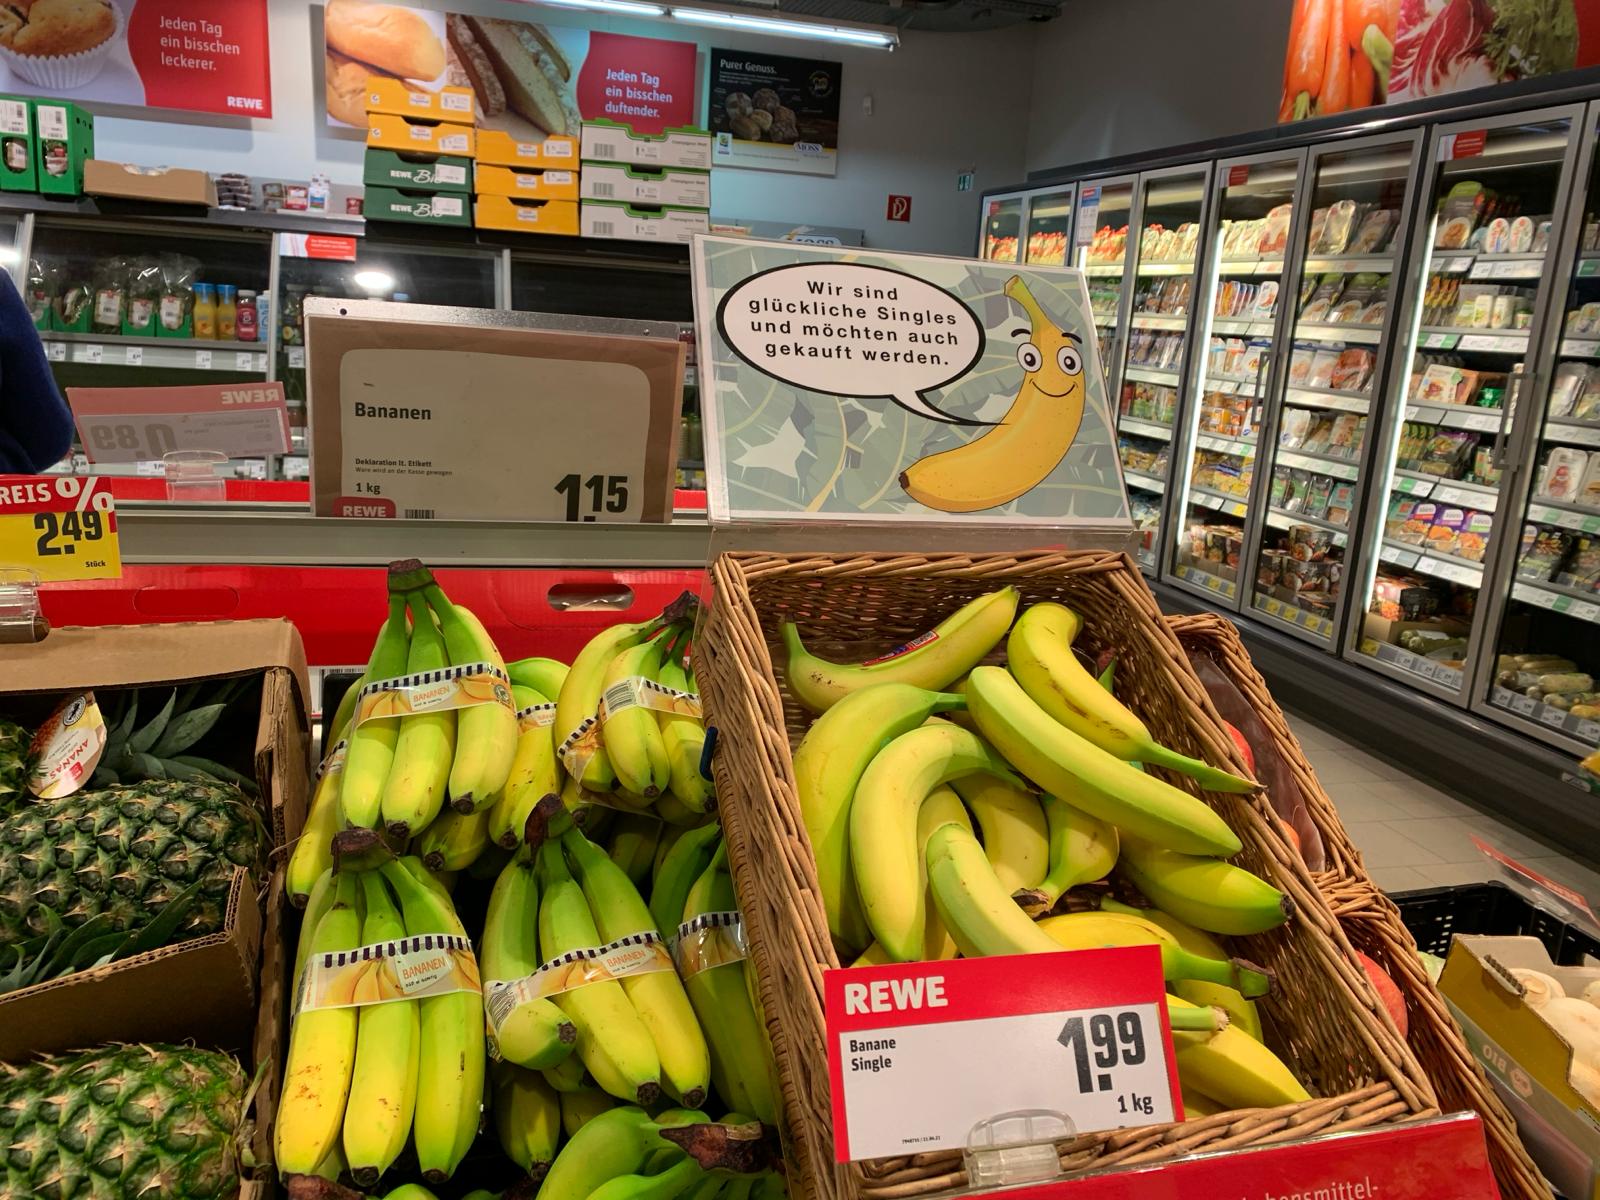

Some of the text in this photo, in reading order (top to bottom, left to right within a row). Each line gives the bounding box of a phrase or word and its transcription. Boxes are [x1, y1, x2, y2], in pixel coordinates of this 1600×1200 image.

[159, 15, 223, 38] Jeden Tag
[160, 34, 240, 55] ein bisschen
[161, 52, 217, 71] leckerer.
[720, 59, 777, 74] Purer Genuss.
[606, 68, 660, 88] Jeden Tag
[226, 95, 264, 110] REWE
[605, 85, 673, 103] ein bisschen
[605, 101, 660, 118] duftender.
[807, 280, 899, 301] Wir sind
[748, 298, 957, 326] glückliche Singles
[751, 319, 959, 346] und möchten auch
[765, 341, 949, 365] gekauft werden.
[354, 402, 431, 421] Bananen
[355, 458, 397, 466] Deklaration
[355, 482, 381, 495] 1 kg
[554, 474, 628, 522] 1.15
[342, 505, 387, 517] REWE
[34, 511, 103, 556] 2.49
[85, 560, 106, 568] Stück
[413, 684, 449, 703] BANANEN
[403, 956, 446, 980] BANANEN
[607, 950, 646, 968] BANANEN
[844, 976, 948, 1016] REWE
[849, 1037, 896, 1053] Banane
[1056, 1011, 1147, 1094] 1.99
[851, 1055, 892, 1072] Single
[1117, 1093, 1154, 1114] 1 kg
